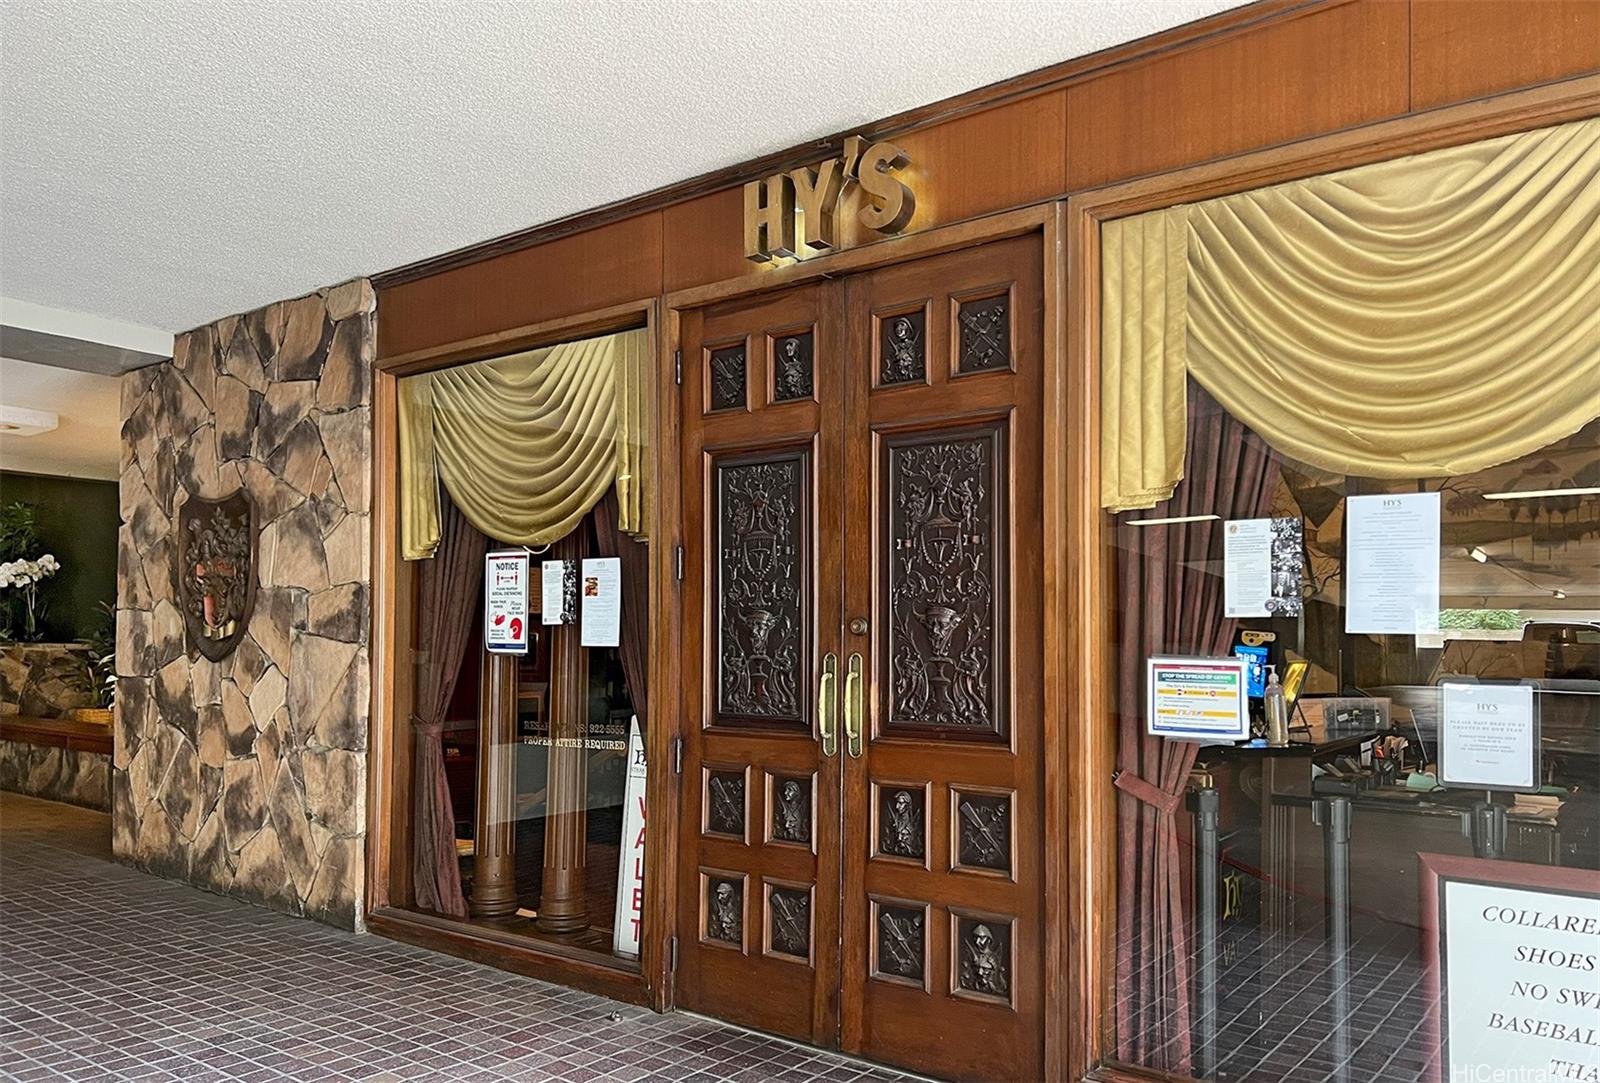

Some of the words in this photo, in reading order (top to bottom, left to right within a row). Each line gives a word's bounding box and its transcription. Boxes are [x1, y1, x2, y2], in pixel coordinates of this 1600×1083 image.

[744, 135, 916, 263] HY'S
[496, 562, 519, 570] NOTICE
[589, 724, 625, 735] 922-5555
[555, 738, 583, 748] ATTIRE
[584, 739, 626, 750] REQUIRED
[1482, 905, 1600, 935] COLLARE
[1513, 945, 1597, 972] SHOES
[1510, 980, 1548, 1001] NO
[1487, 1012, 1600, 1046] BASEBAL
